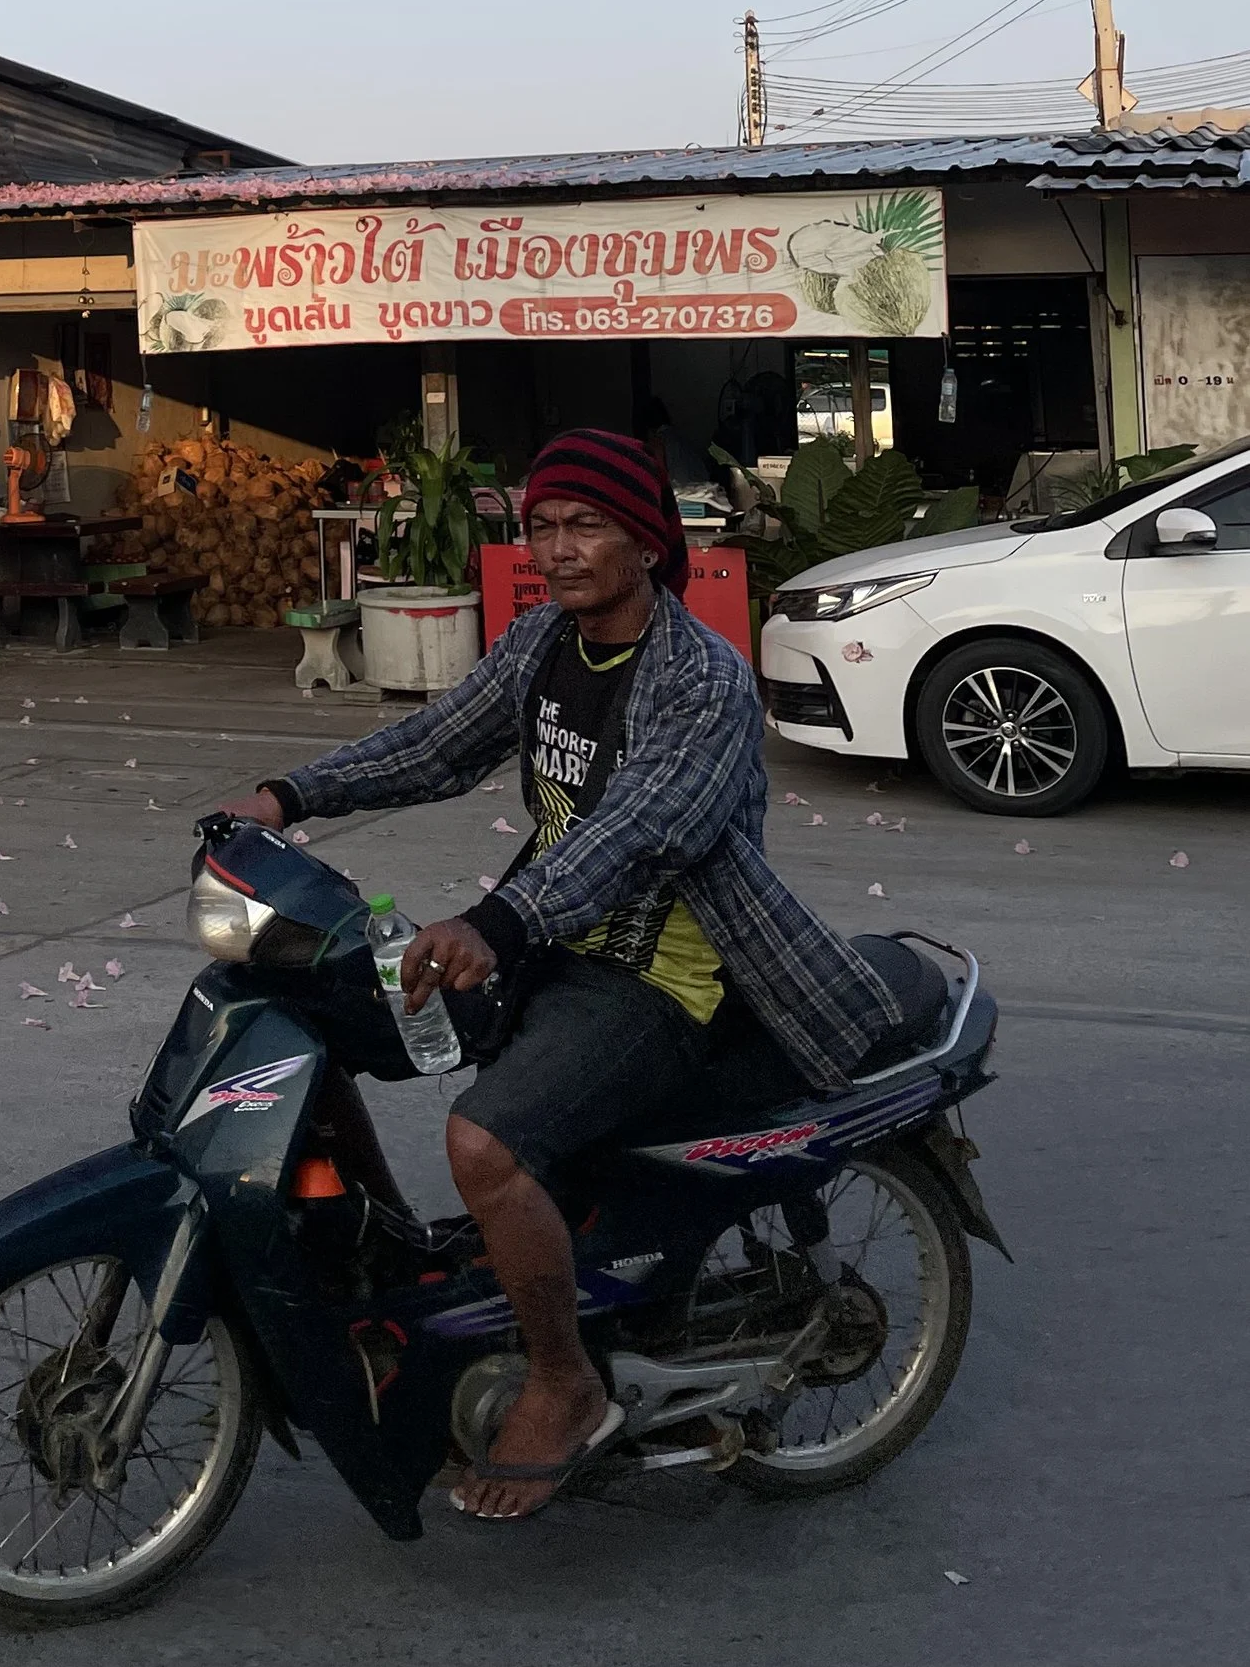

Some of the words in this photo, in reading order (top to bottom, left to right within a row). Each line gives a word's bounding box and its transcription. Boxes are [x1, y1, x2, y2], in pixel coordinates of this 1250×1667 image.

[168, 215, 446, 293] มะพร้าวใต้
[454, 216, 780, 304] เมืองชุมพร
[243, 293, 350, 344] ขูดเส้น
[378, 299, 493, 340] ขูดขาว
[611, 1251, 664, 1269] HONDA
